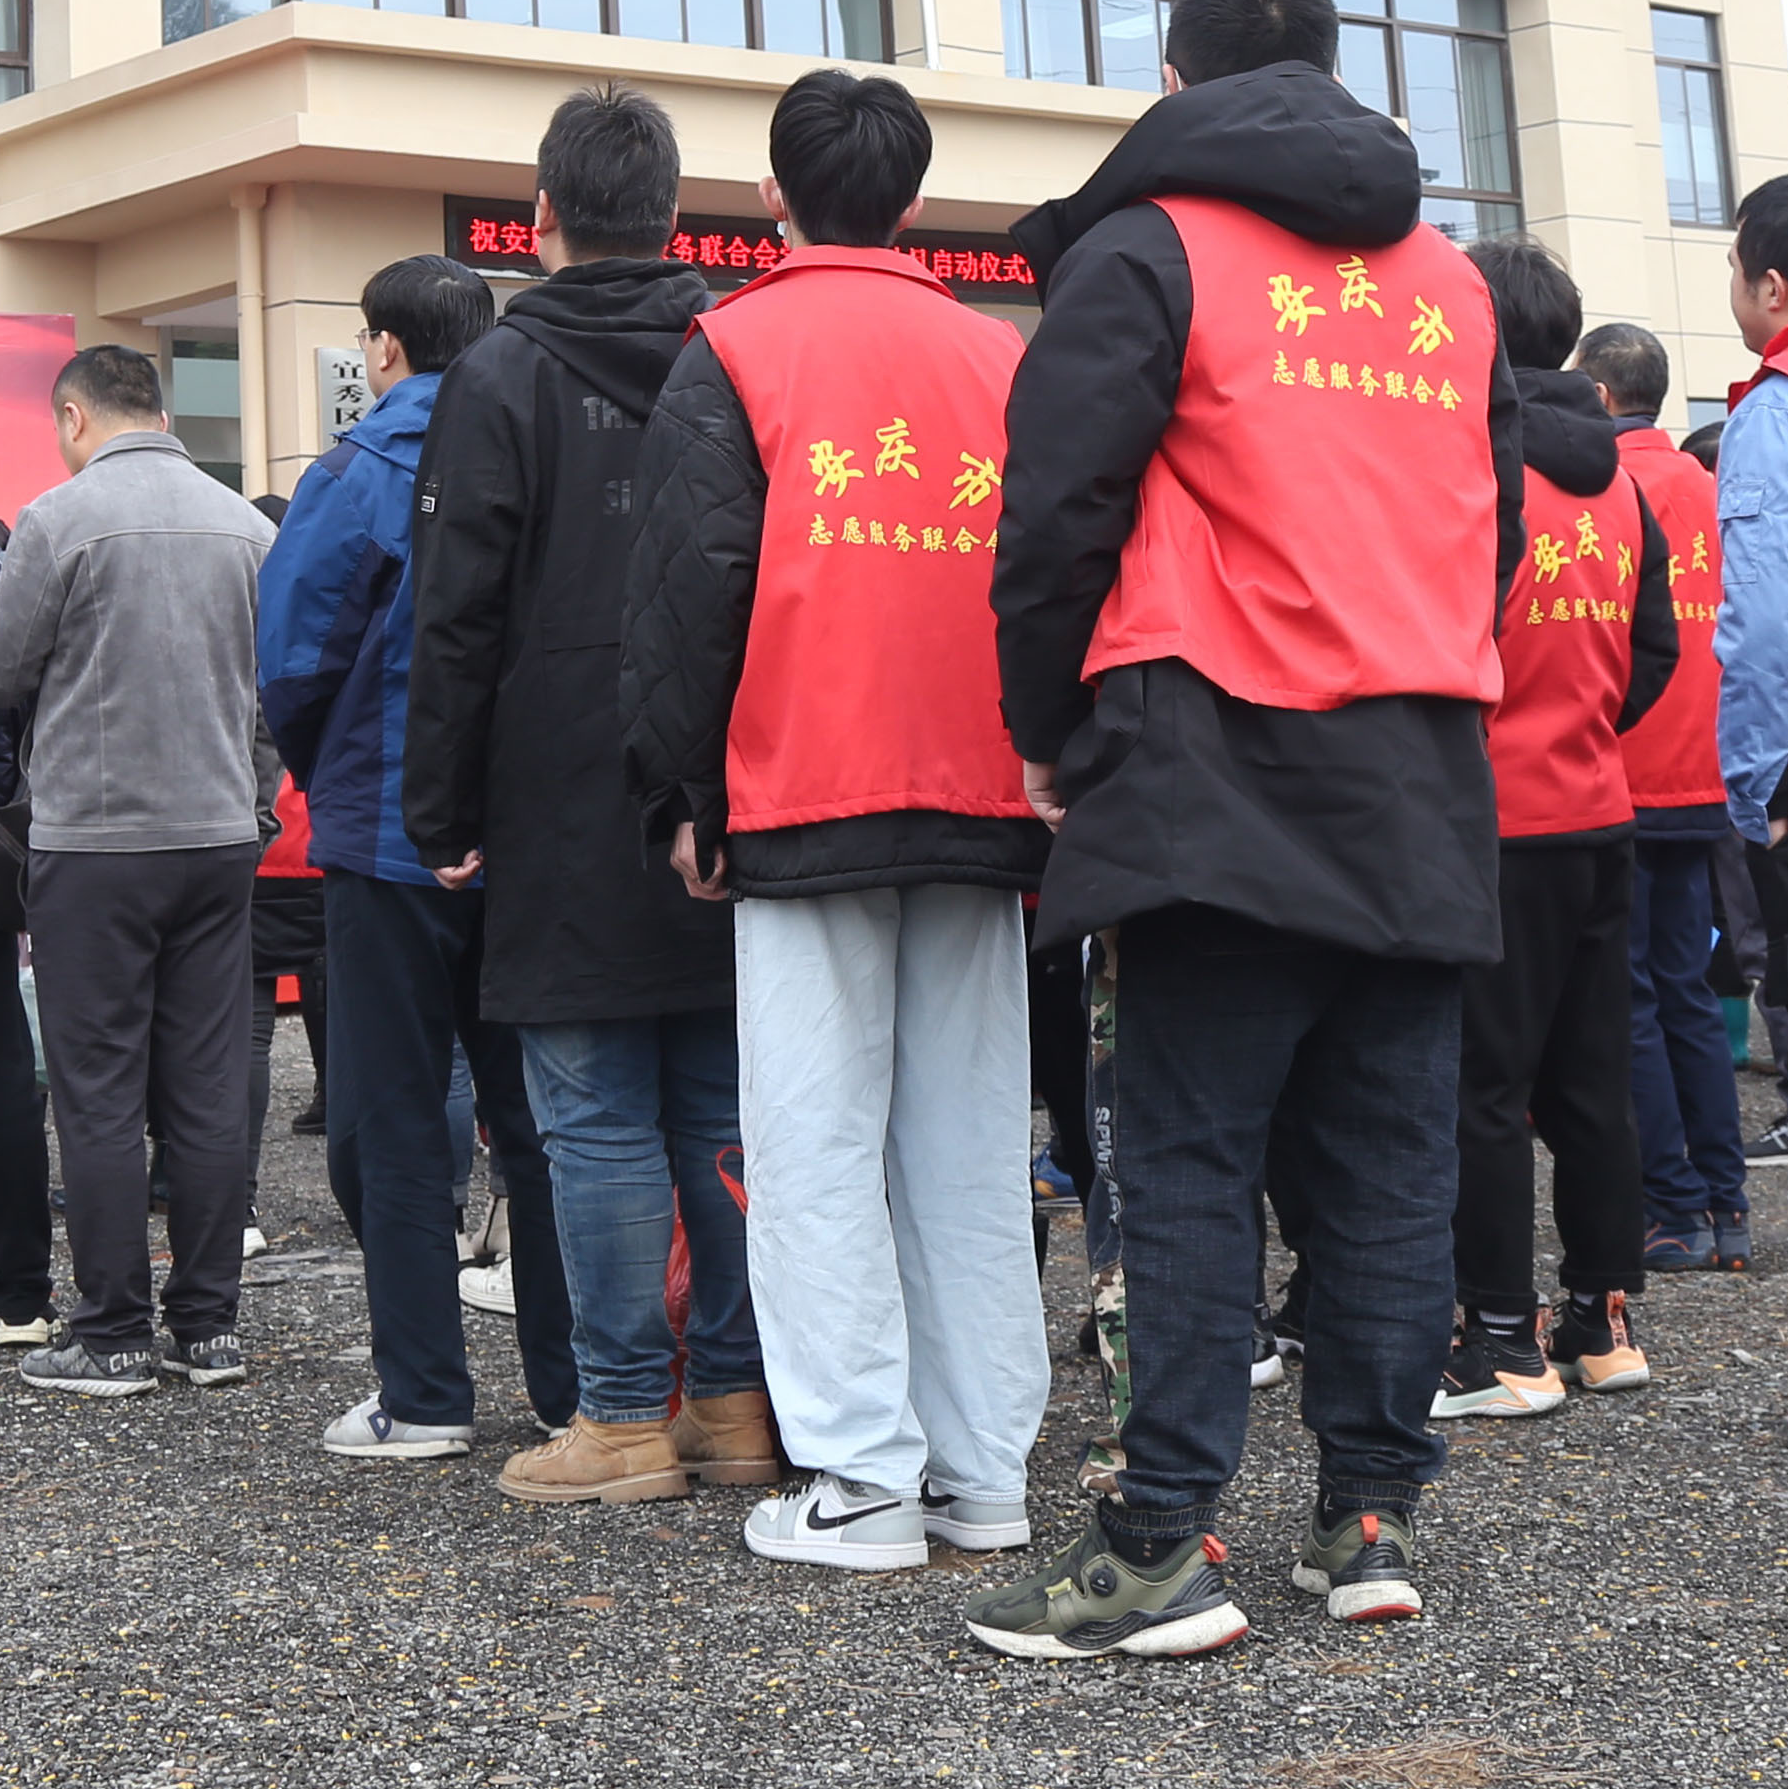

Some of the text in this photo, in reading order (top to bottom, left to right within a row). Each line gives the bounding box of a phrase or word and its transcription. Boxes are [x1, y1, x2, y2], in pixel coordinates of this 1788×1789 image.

[1272, 350, 1463, 412] 志愿服务联合会
[582, 396, 640, 431] TH
